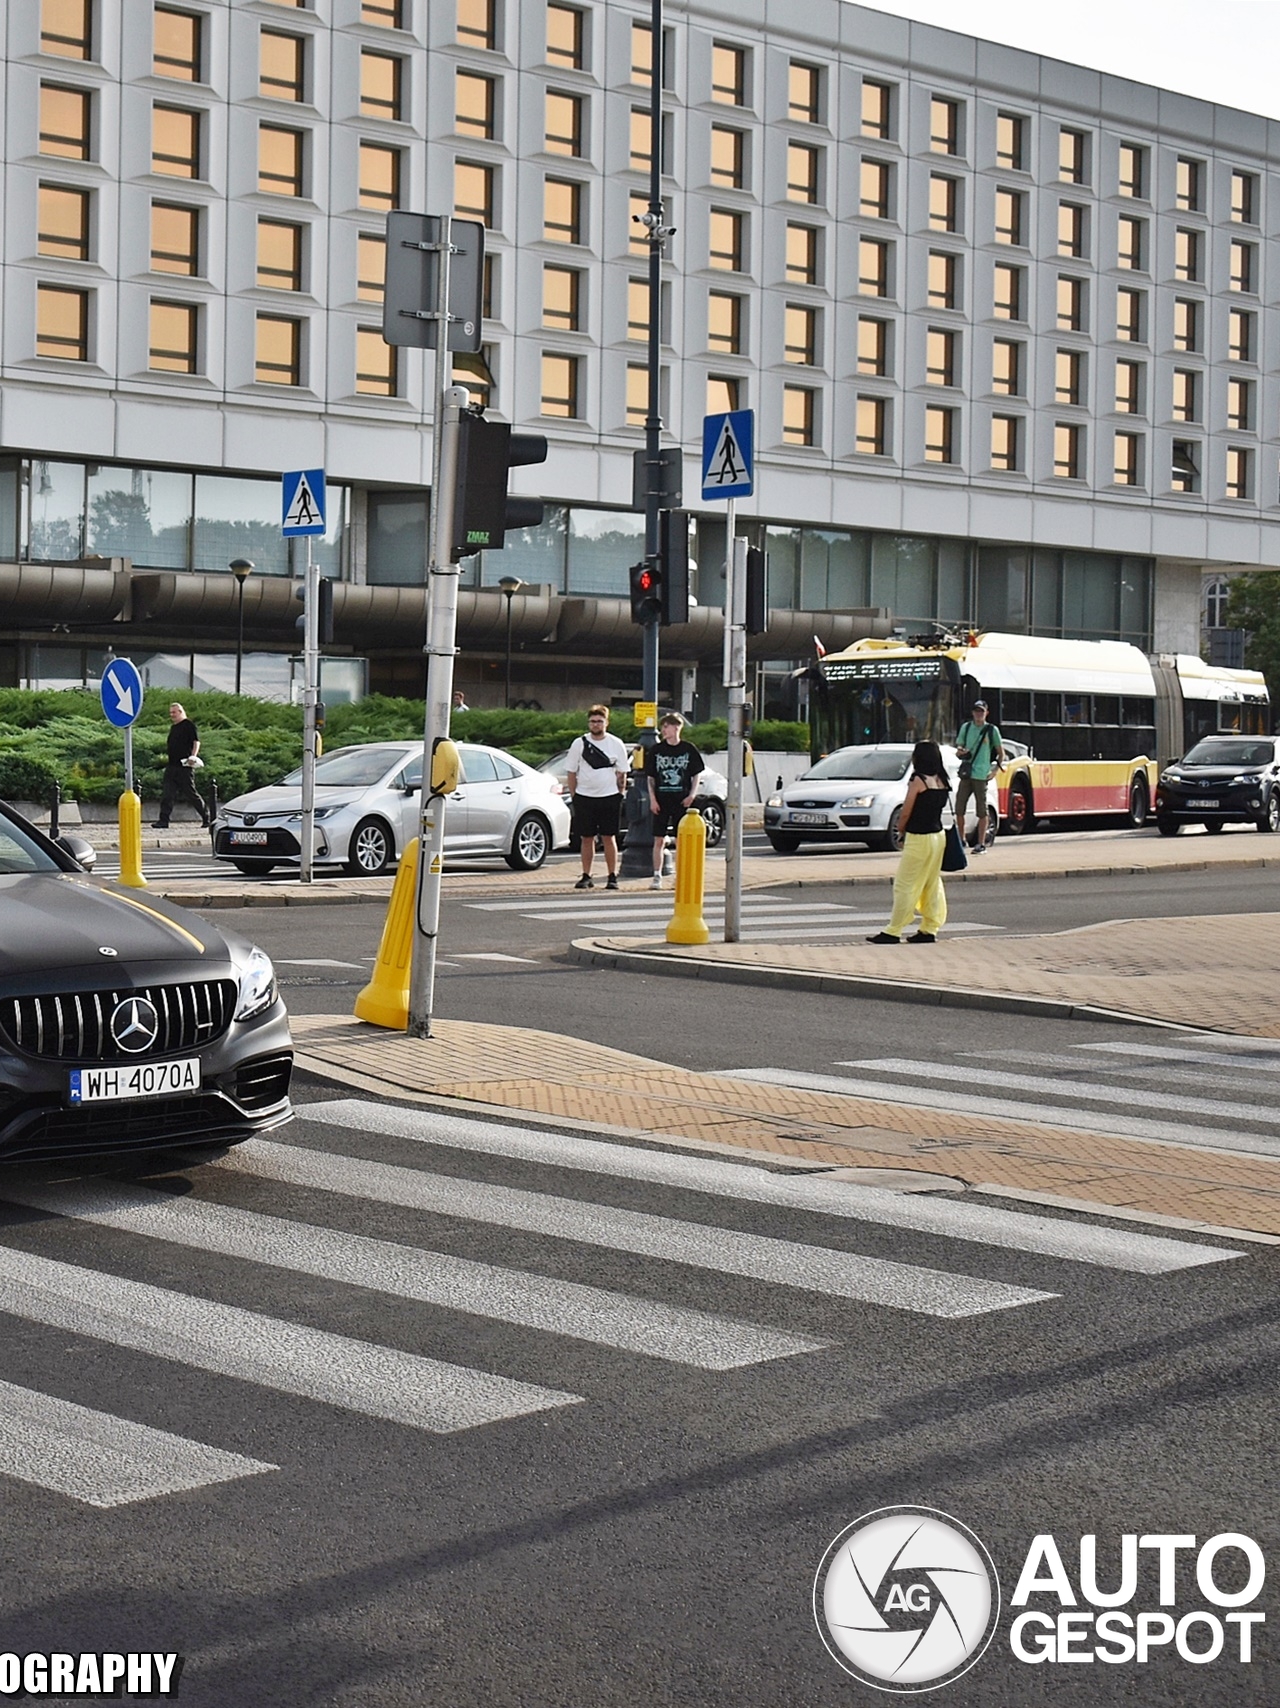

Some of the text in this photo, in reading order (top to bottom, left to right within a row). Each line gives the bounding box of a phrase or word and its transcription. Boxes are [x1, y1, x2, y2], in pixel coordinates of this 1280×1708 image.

[655, 752, 689, 772] ROUGH
[88, 1062, 194, 1097] WH 4070A
[71, 1089, 81, 1097] PL
